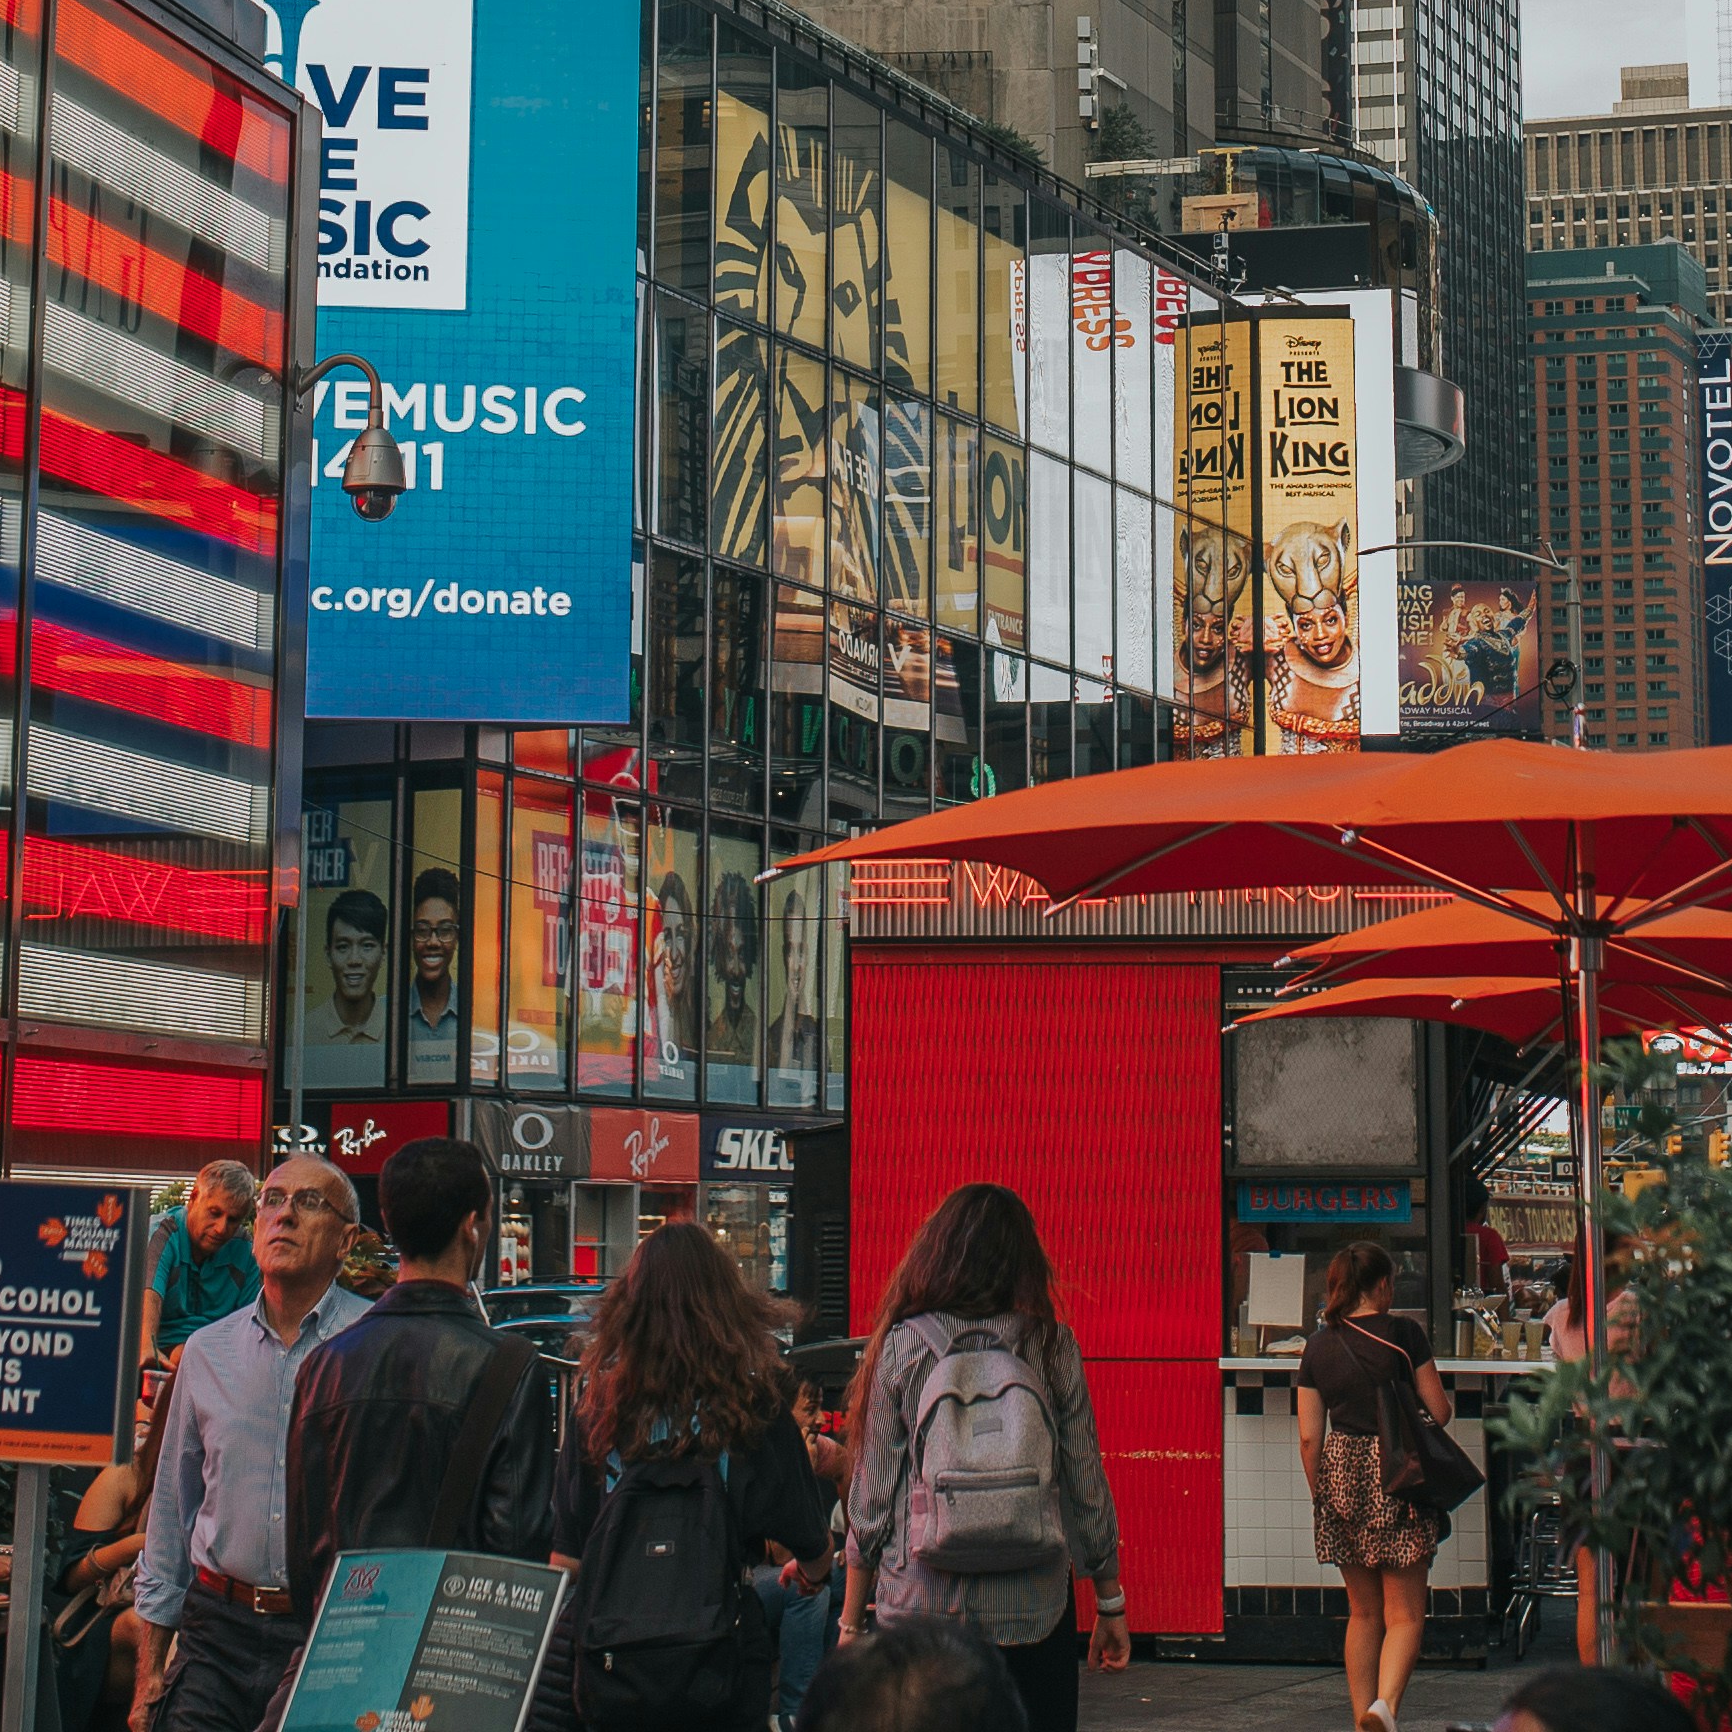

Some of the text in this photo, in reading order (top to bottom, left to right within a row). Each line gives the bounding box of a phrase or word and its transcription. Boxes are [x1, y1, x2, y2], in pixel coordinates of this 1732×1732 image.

[1280, 360, 1328, 383] THE
[1273, 389, 1339, 428] LION
[1269, 431, 1350, 478] KING
[1433, 707, 1472, 715] MUSICAL
[500, 1153, 564, 1173] OAKLEY
[1249, 1185, 1400, 1210] BURGERS
[469, 1576, 494, 1595] ICE
[511, 1584, 544, 1604] VICE
